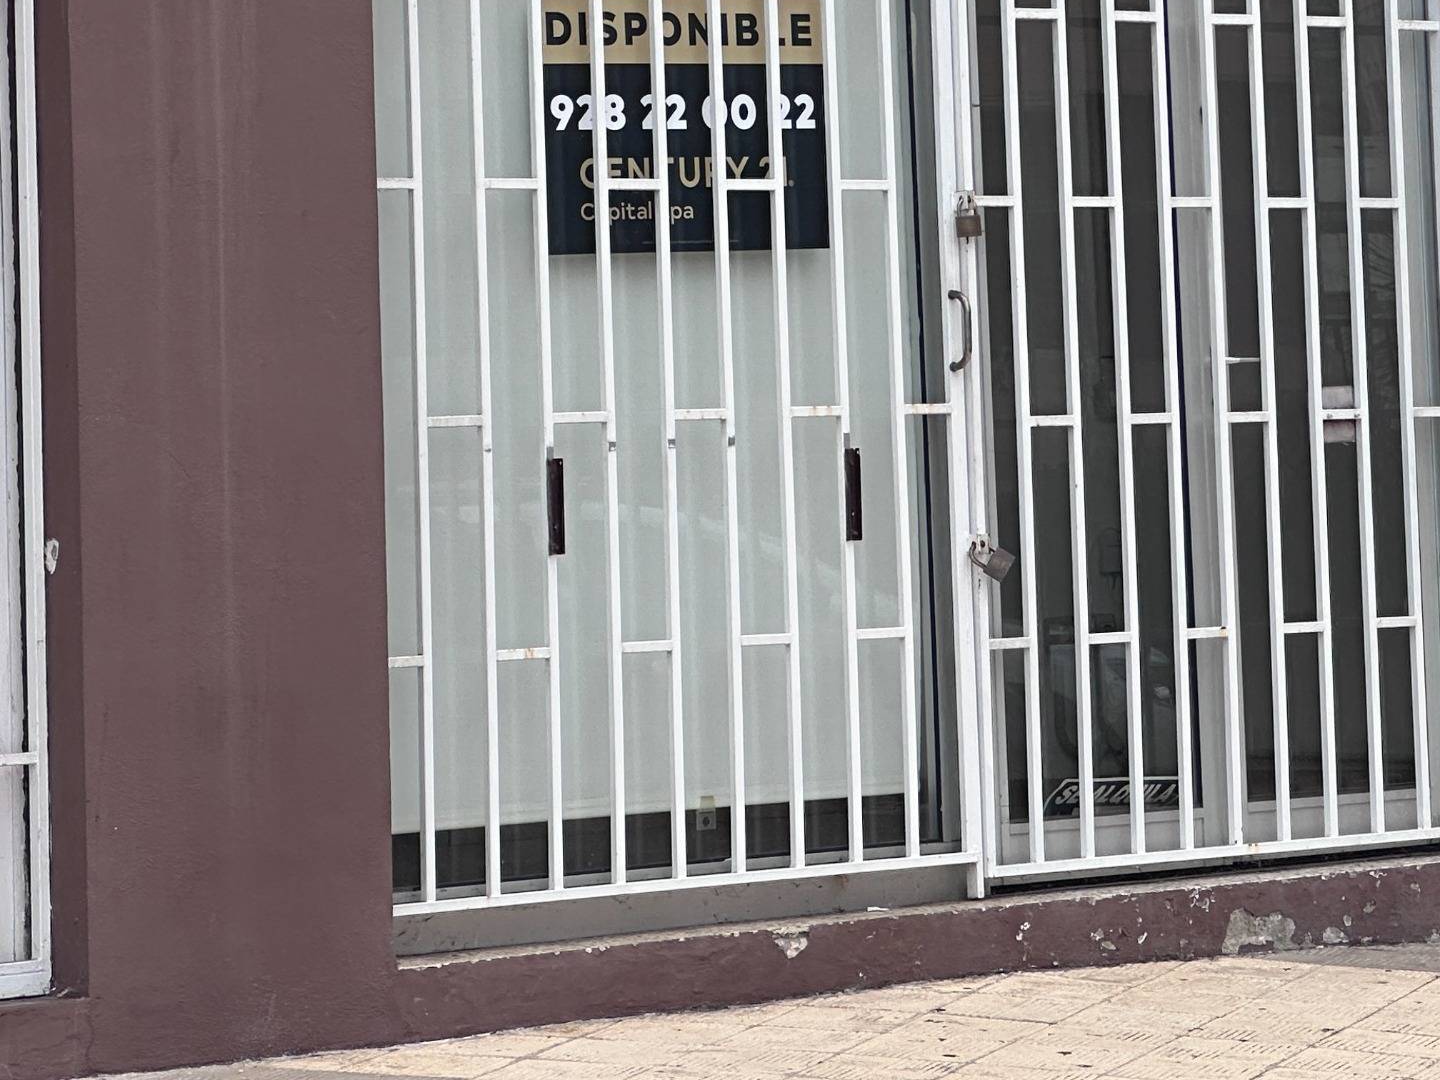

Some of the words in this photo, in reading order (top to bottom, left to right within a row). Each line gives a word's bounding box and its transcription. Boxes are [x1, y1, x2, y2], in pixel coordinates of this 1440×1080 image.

[544, 11, 812, 46] DISPONIBE
[550, 94, 627, 130] 928
[640, 94, 688, 130] 22
[773, 93, 816, 129] 22
[579, 156, 749, 189] CENUY
[580, 201, 653, 226] Cpital
[667, 205, 694, 225] pa
